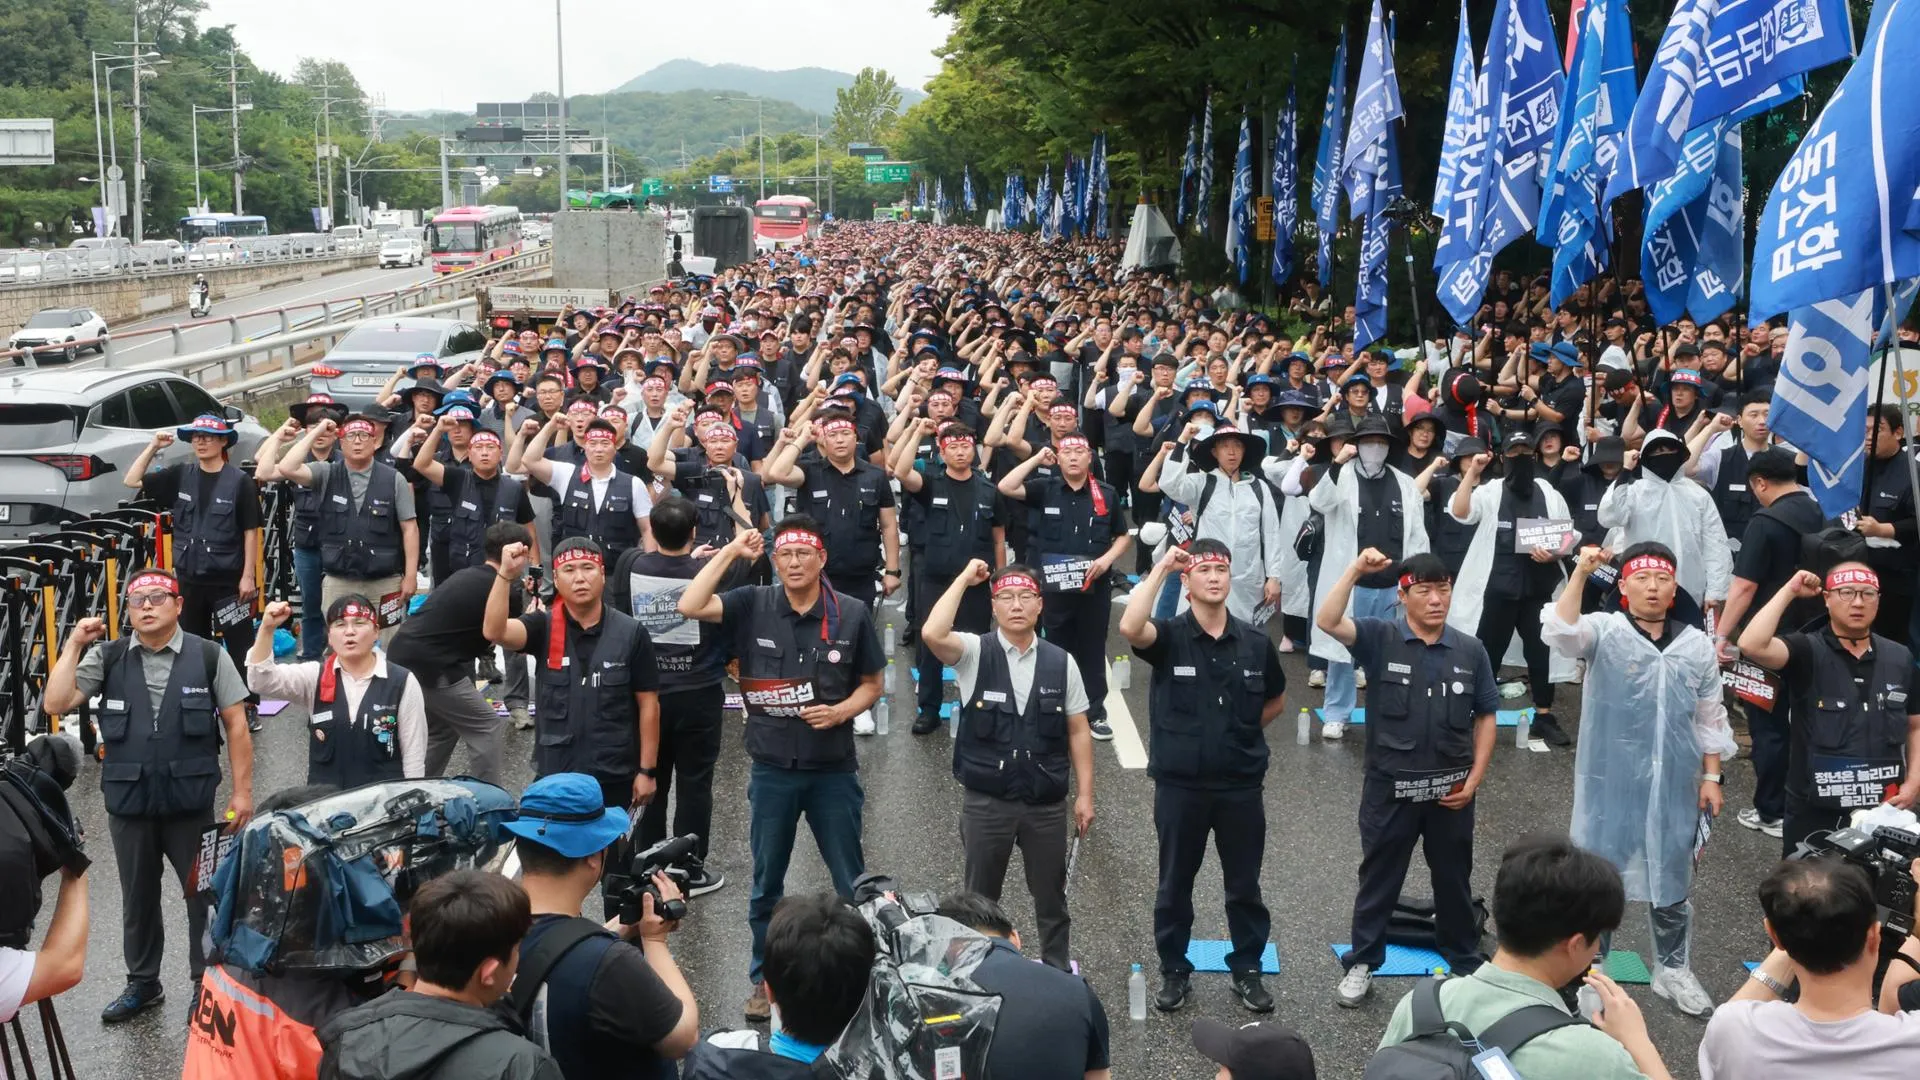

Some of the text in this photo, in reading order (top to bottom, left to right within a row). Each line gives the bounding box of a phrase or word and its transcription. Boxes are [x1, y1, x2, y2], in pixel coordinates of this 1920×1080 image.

[517, 295, 585, 305] HYUNDAI
[745, 681, 815, 705] 원청교섭
[1814, 770, 1855, 785] 정년은
[1817, 782, 1884, 797] 납품단가는
[1840, 794, 1880, 808] 올리고
